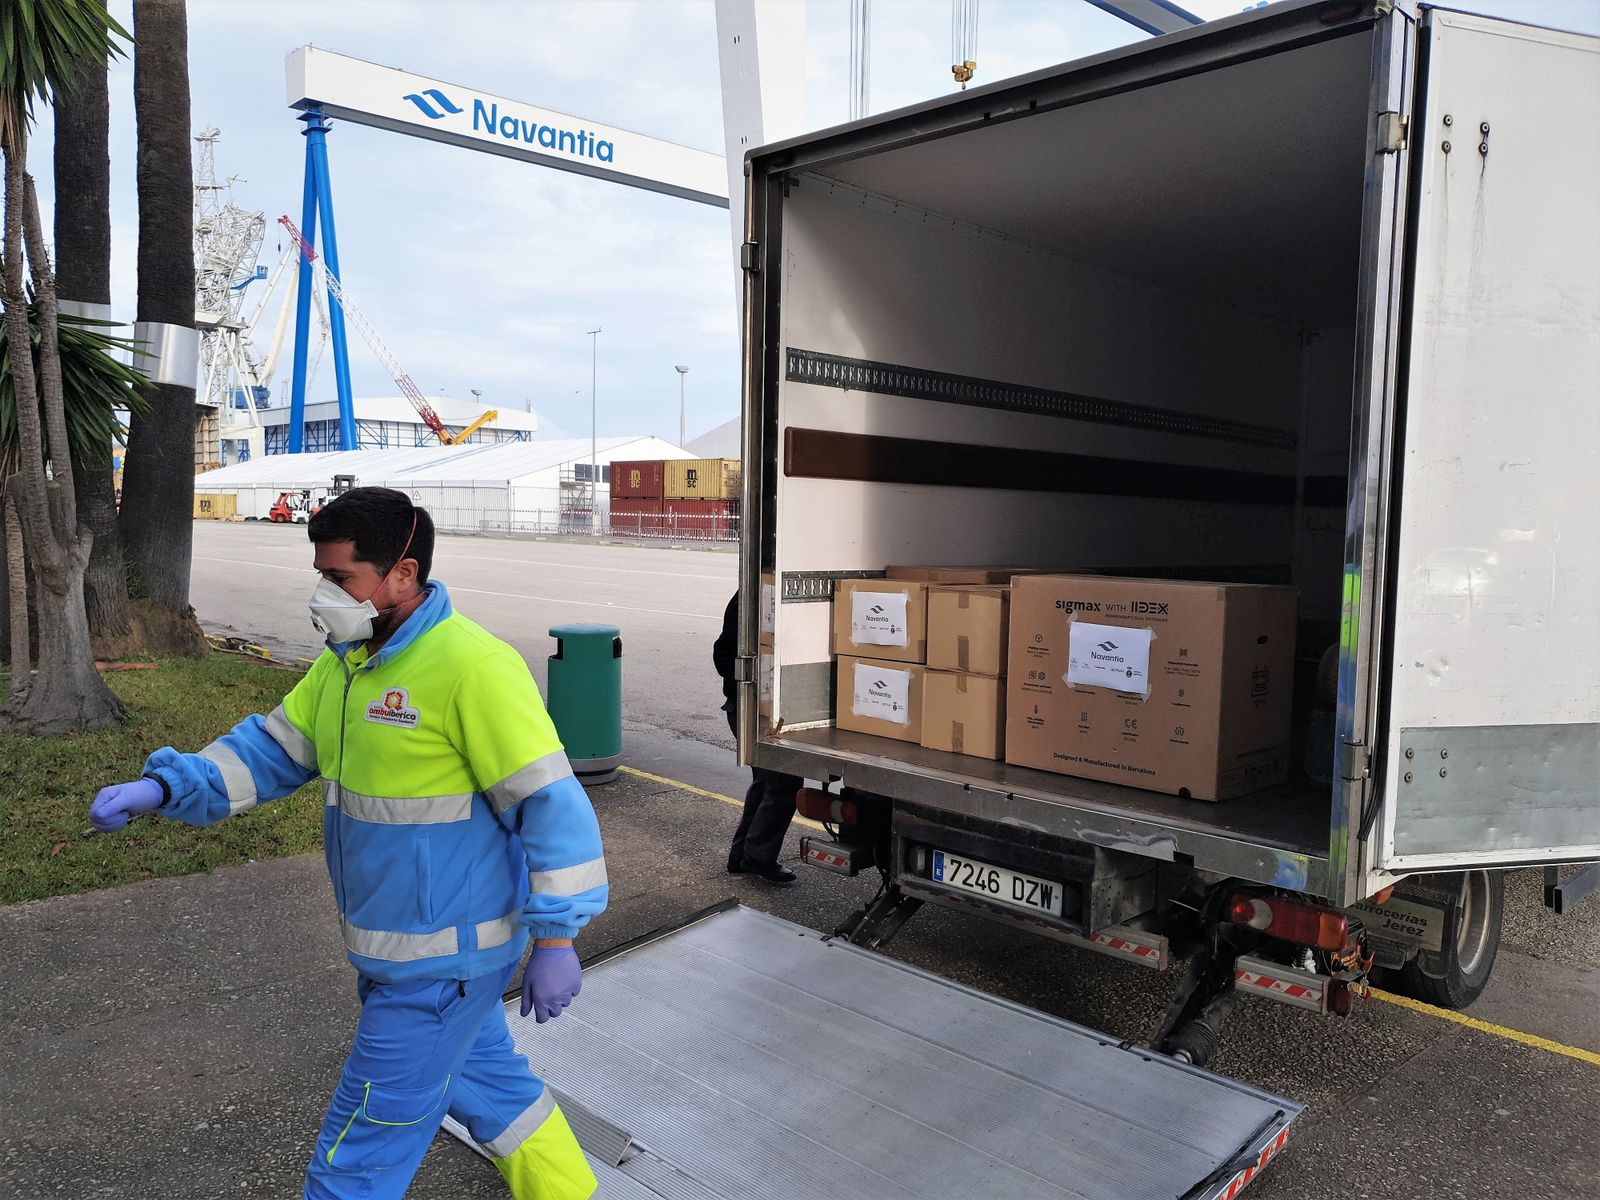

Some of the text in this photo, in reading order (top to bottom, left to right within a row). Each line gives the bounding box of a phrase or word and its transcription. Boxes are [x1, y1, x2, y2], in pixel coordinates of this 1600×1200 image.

[473, 98, 614, 163] Navantia
[1055, 600, 1101, 614] sigmax
[1105, 604, 1127, 612] WITH
[865, 614, 889, 623] Navantia
[1091, 651, 1125, 663] Navantia
[1053, 752, 1078, 762] Designed
[1083, 758, 1121, 769] Manufactured
[1127, 765, 1156, 776] Barcelona
[936, 868, 941, 876] E
[949, 858, 1053, 910] 7246 DZW
[1382, 918, 1425, 937] Jerez
